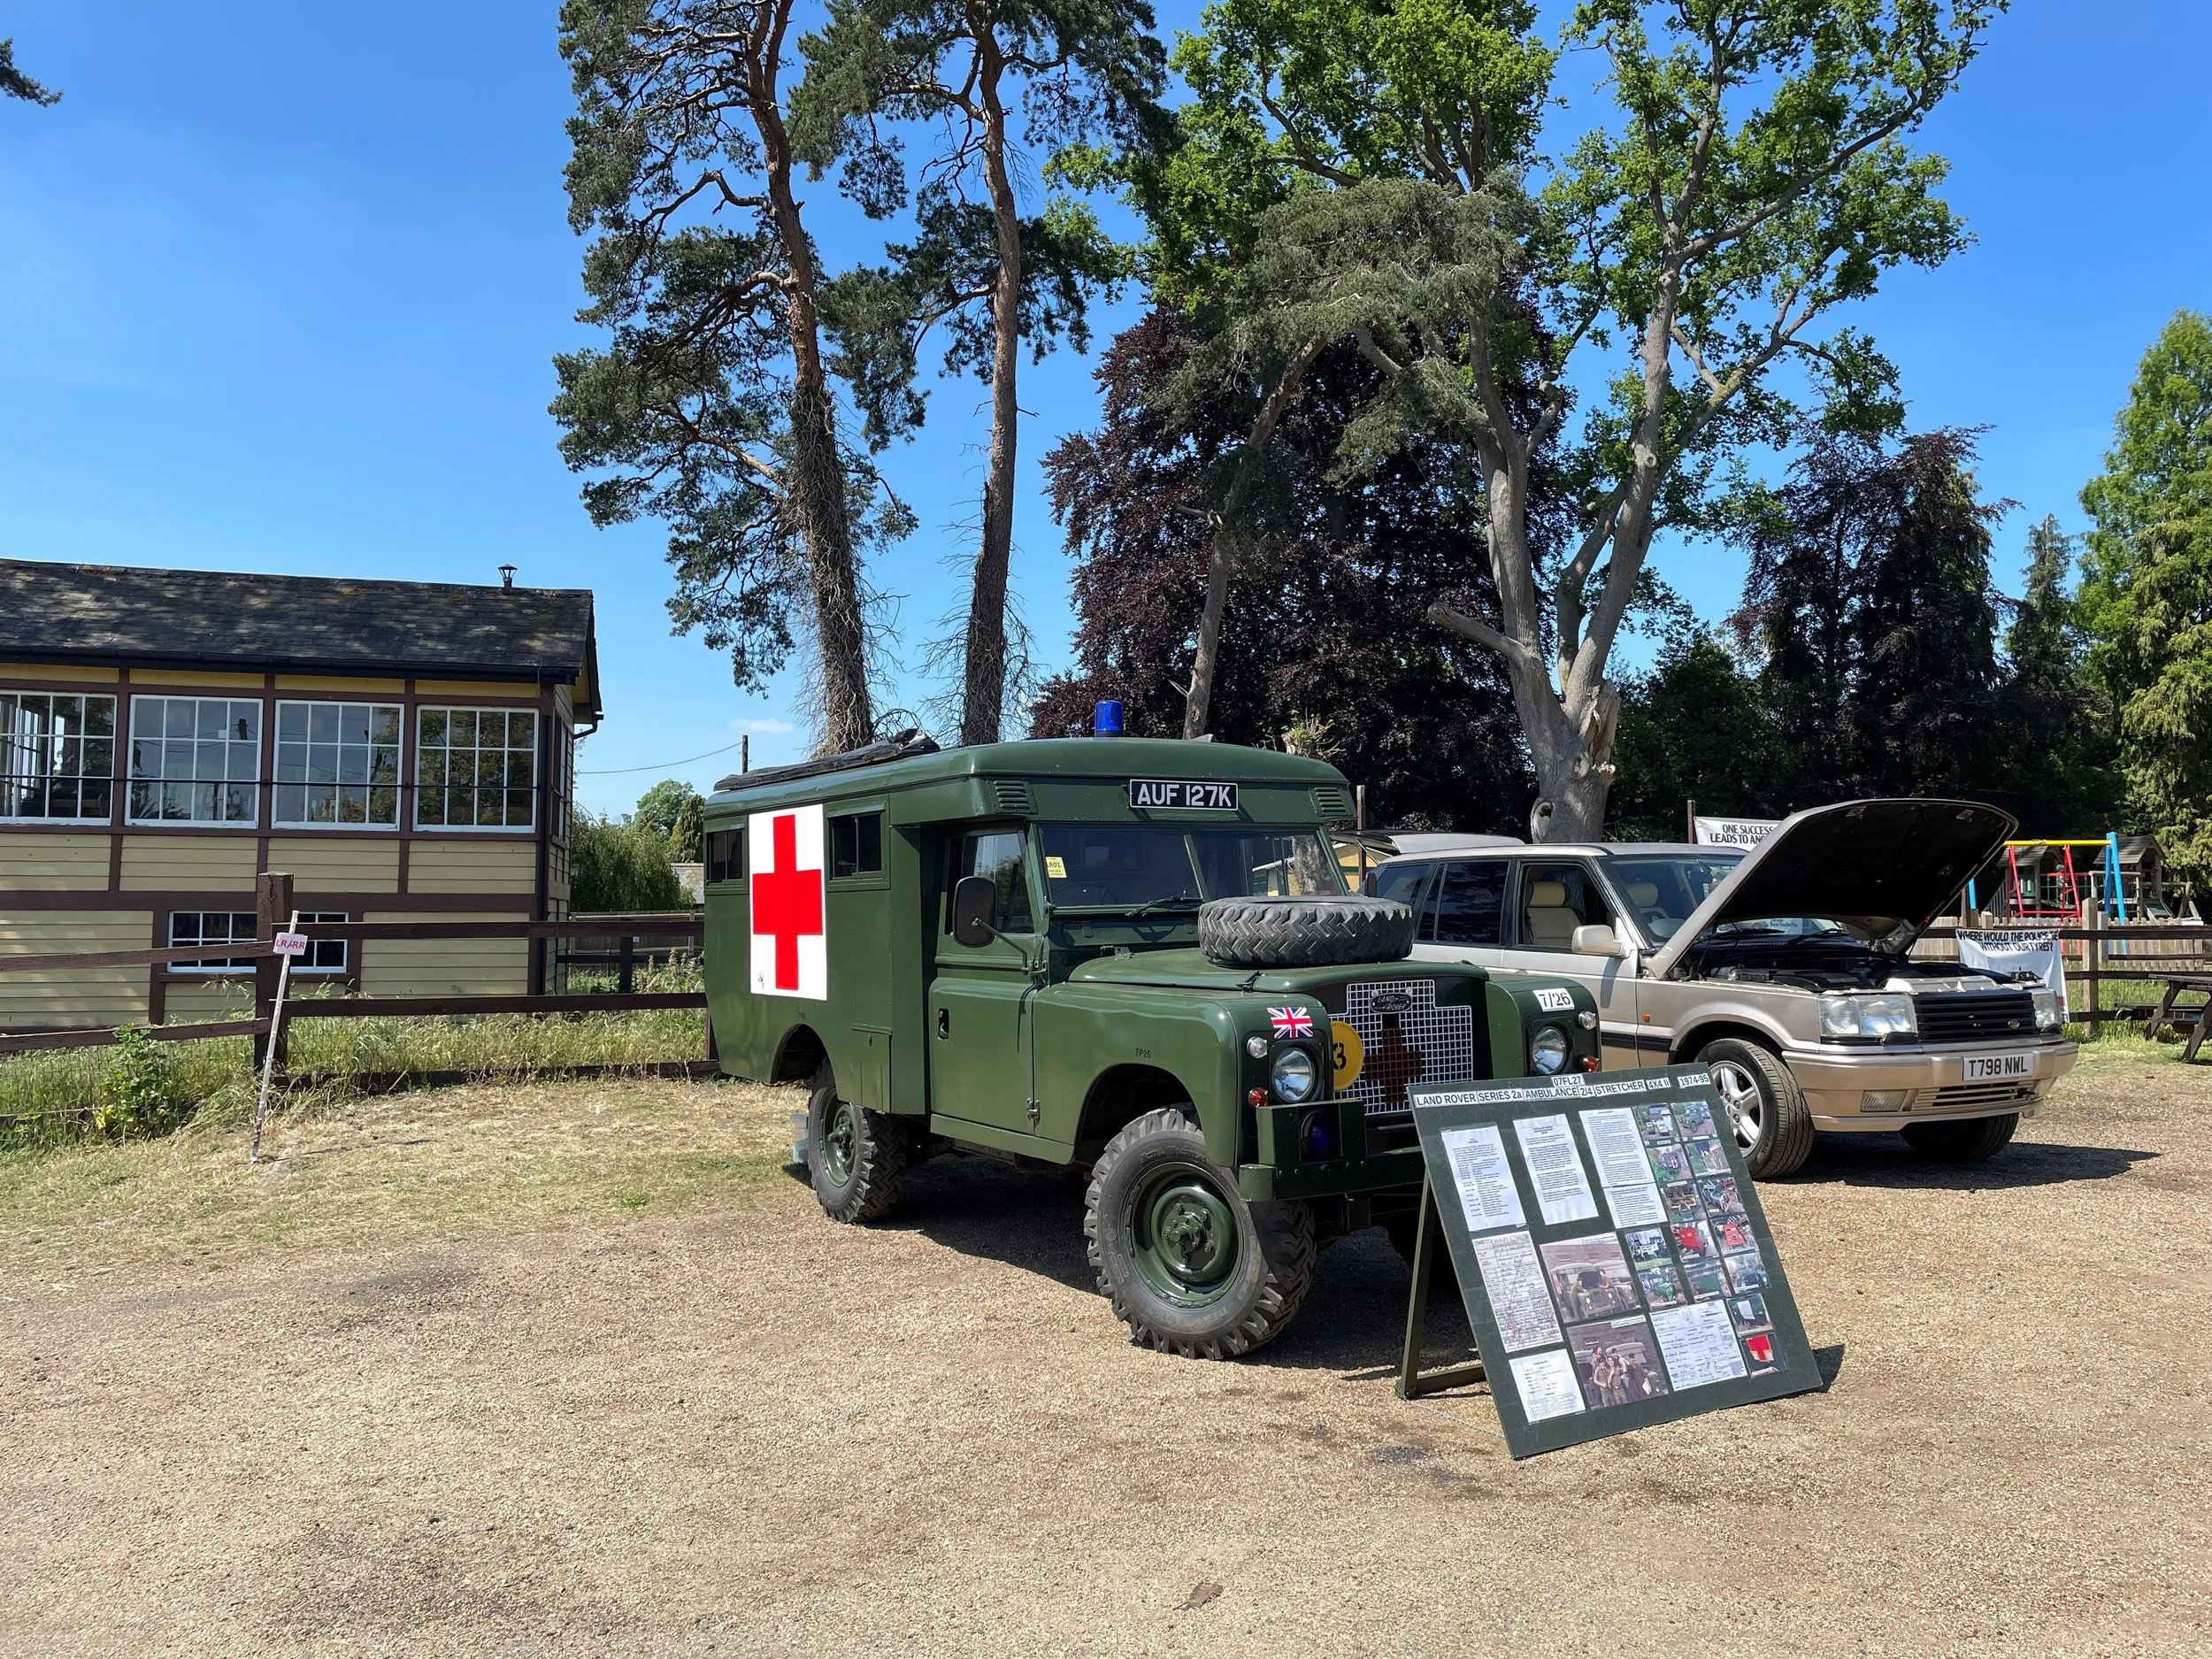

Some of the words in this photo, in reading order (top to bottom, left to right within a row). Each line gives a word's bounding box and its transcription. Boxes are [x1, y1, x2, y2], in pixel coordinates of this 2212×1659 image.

[1137, 783, 1179, 805] AUF
[1186, 785, 1232, 807] 127K
[1722, 824, 1740, 834] ONE
[1710, 833, 1737, 843] LEADS
[1738, 834, 1748, 843] TO
[1956, 930, 1983, 941] WHERE
[1983, 932, 2008, 941] WOULD
[2010, 932, 2024, 941] THE
[1978, 941, 2013, 951] WITHOUT
[2014, 942, 2031, 951] OUR
[1538, 992, 1571, 1007] 7/26
[1135, 1048, 1151, 1059] TP25
[1969, 1058, 2001, 1077] T798
[2005, 1056, 2027, 1074] NWL
[1553, 1076, 1581, 1087] 07FL27
[1416, 1095, 1442, 1106] LAND
[1444, 1093, 1477, 1104] ROVER
[1479, 1091, 1509, 1102] SERIES
[1511, 1090, 1523, 1099] 2a
[1525, 1087, 1578, 1099] AMBULANCE
[1580, 1087, 1593, 1096] 2/4
[1596, 1081, 1645, 1094] STRETCHER
[1680, 1074, 1709, 1087] 1974-95
